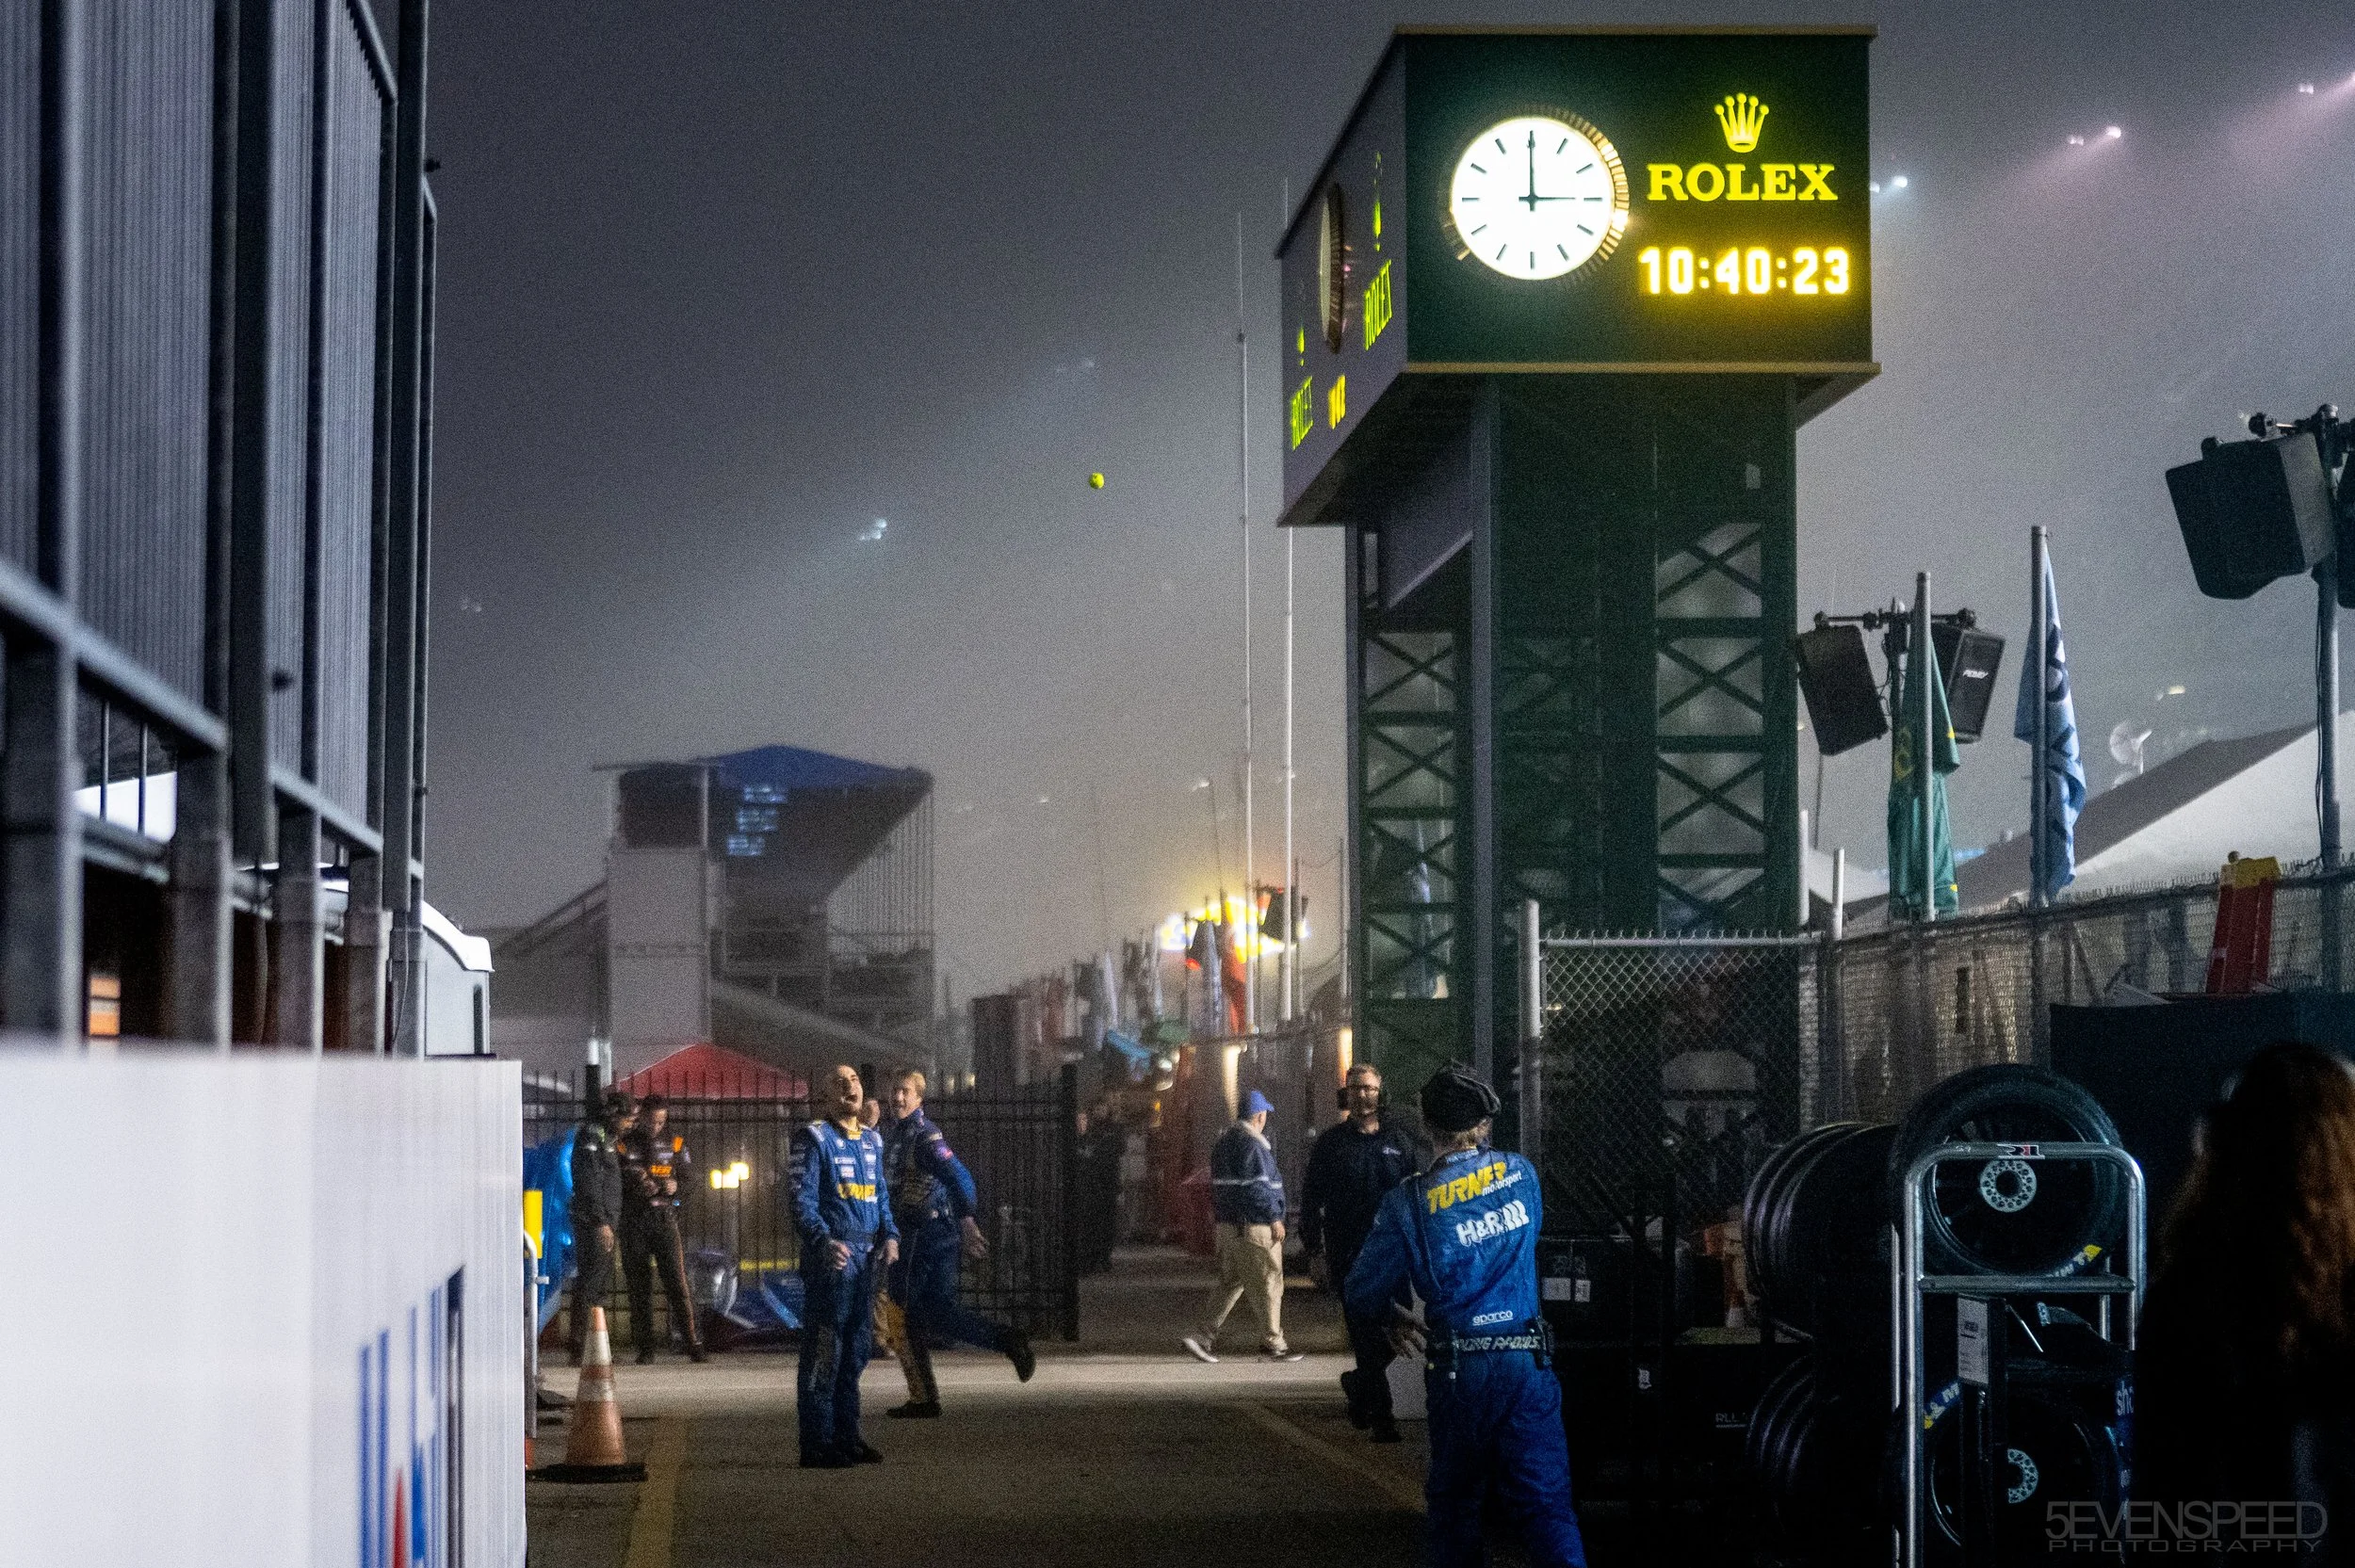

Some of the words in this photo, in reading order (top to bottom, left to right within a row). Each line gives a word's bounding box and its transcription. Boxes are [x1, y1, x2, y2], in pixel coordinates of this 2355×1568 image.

[1647, 163, 1839, 202] ROLEX
[1638, 247, 1850, 296] 10:40:23
[1427, 1161, 1507, 1215] TURNER
[1472, 1310, 1514, 1326] sparco
